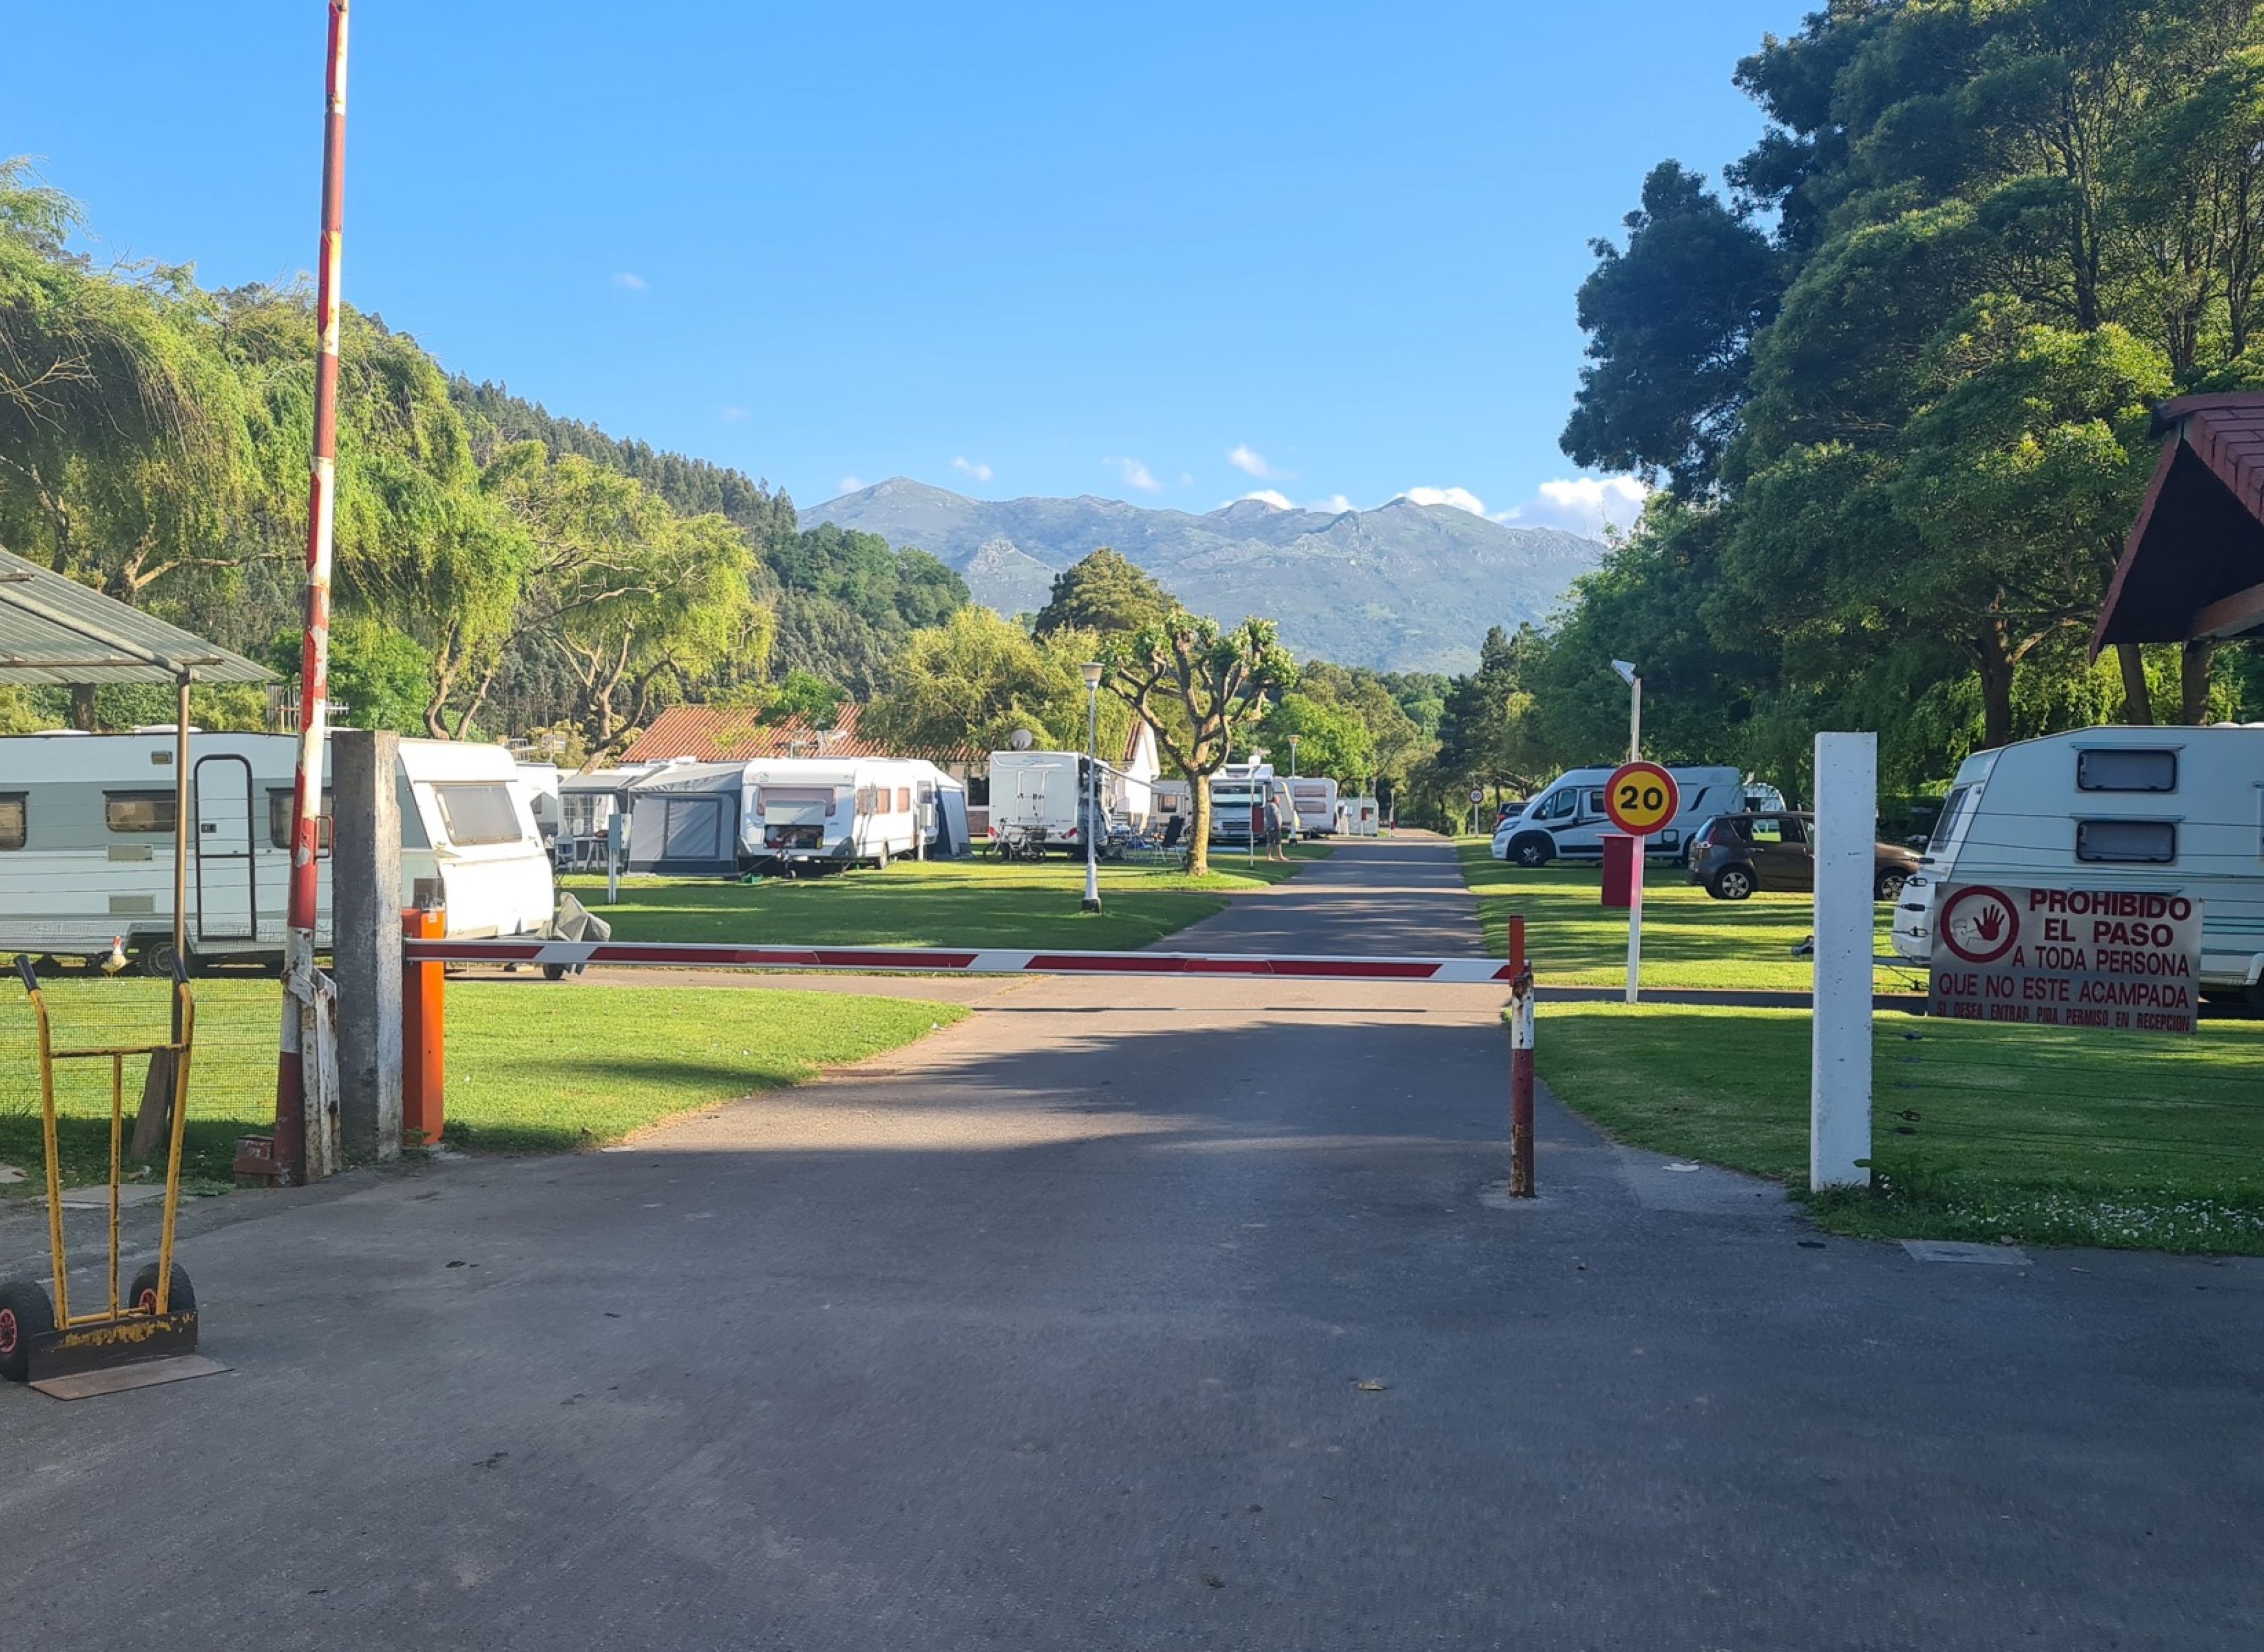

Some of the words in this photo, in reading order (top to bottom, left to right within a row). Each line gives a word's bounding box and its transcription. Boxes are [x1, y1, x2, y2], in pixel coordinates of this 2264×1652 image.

[1620, 786, 1664, 811] 20
[2029, 889, 2191, 921] PROHIBIDO
[2044, 918, 2076, 942] EL
[2093, 920, 2173, 948] PASO
[2012, 945, 2025, 968] A
[2035, 945, 2087, 971] TODA
[2096, 949, 2190, 977] PERSONA
[1938, 973, 1978, 996] QUE
[1985, 974, 2015, 999] NO
[2023, 977, 2070, 1002] ESTE
[2079, 980, 2189, 1008] ACAMPADA
[1937, 1000, 1946, 1016] SI
[1954, 1002, 1983, 1019] DESEA
[1990, 1003, 2030, 1022] ENTRAR
[2037, 1006, 2058, 1024] PIDA
[2066, 1008, 2109, 1026] PERMISO
[2115, 1011, 2129, 1028] EN
[2136, 1013, 2190, 1032] RECEPCION
